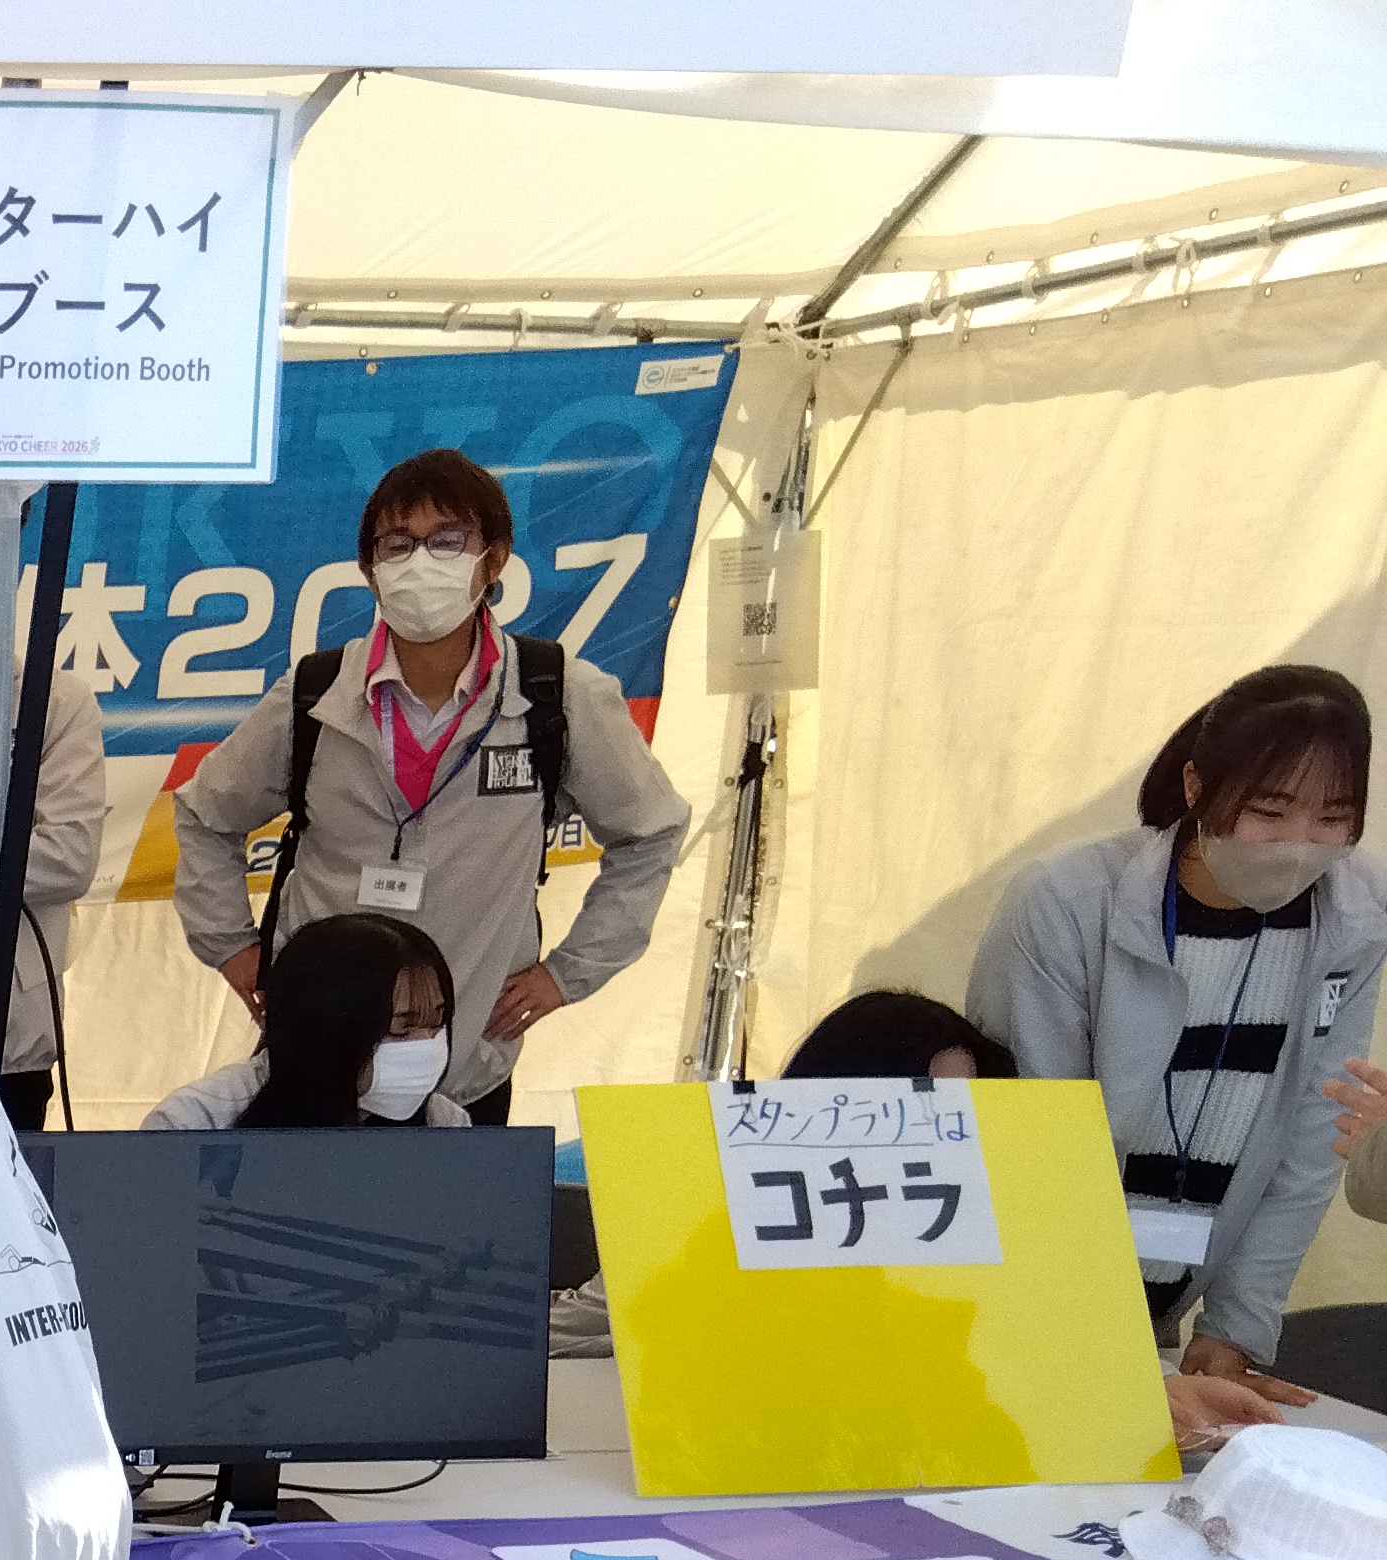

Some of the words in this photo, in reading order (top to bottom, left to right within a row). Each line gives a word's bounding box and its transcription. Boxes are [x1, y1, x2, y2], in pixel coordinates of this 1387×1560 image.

[138, 354, 212, 383] Booth
[20, 440, 59, 453] CHEER
[60, 440, 89, 453] 2026
[728, 1093, 969, 1143] スタンプラリーは
[751, 1157, 963, 1249] コチラ
